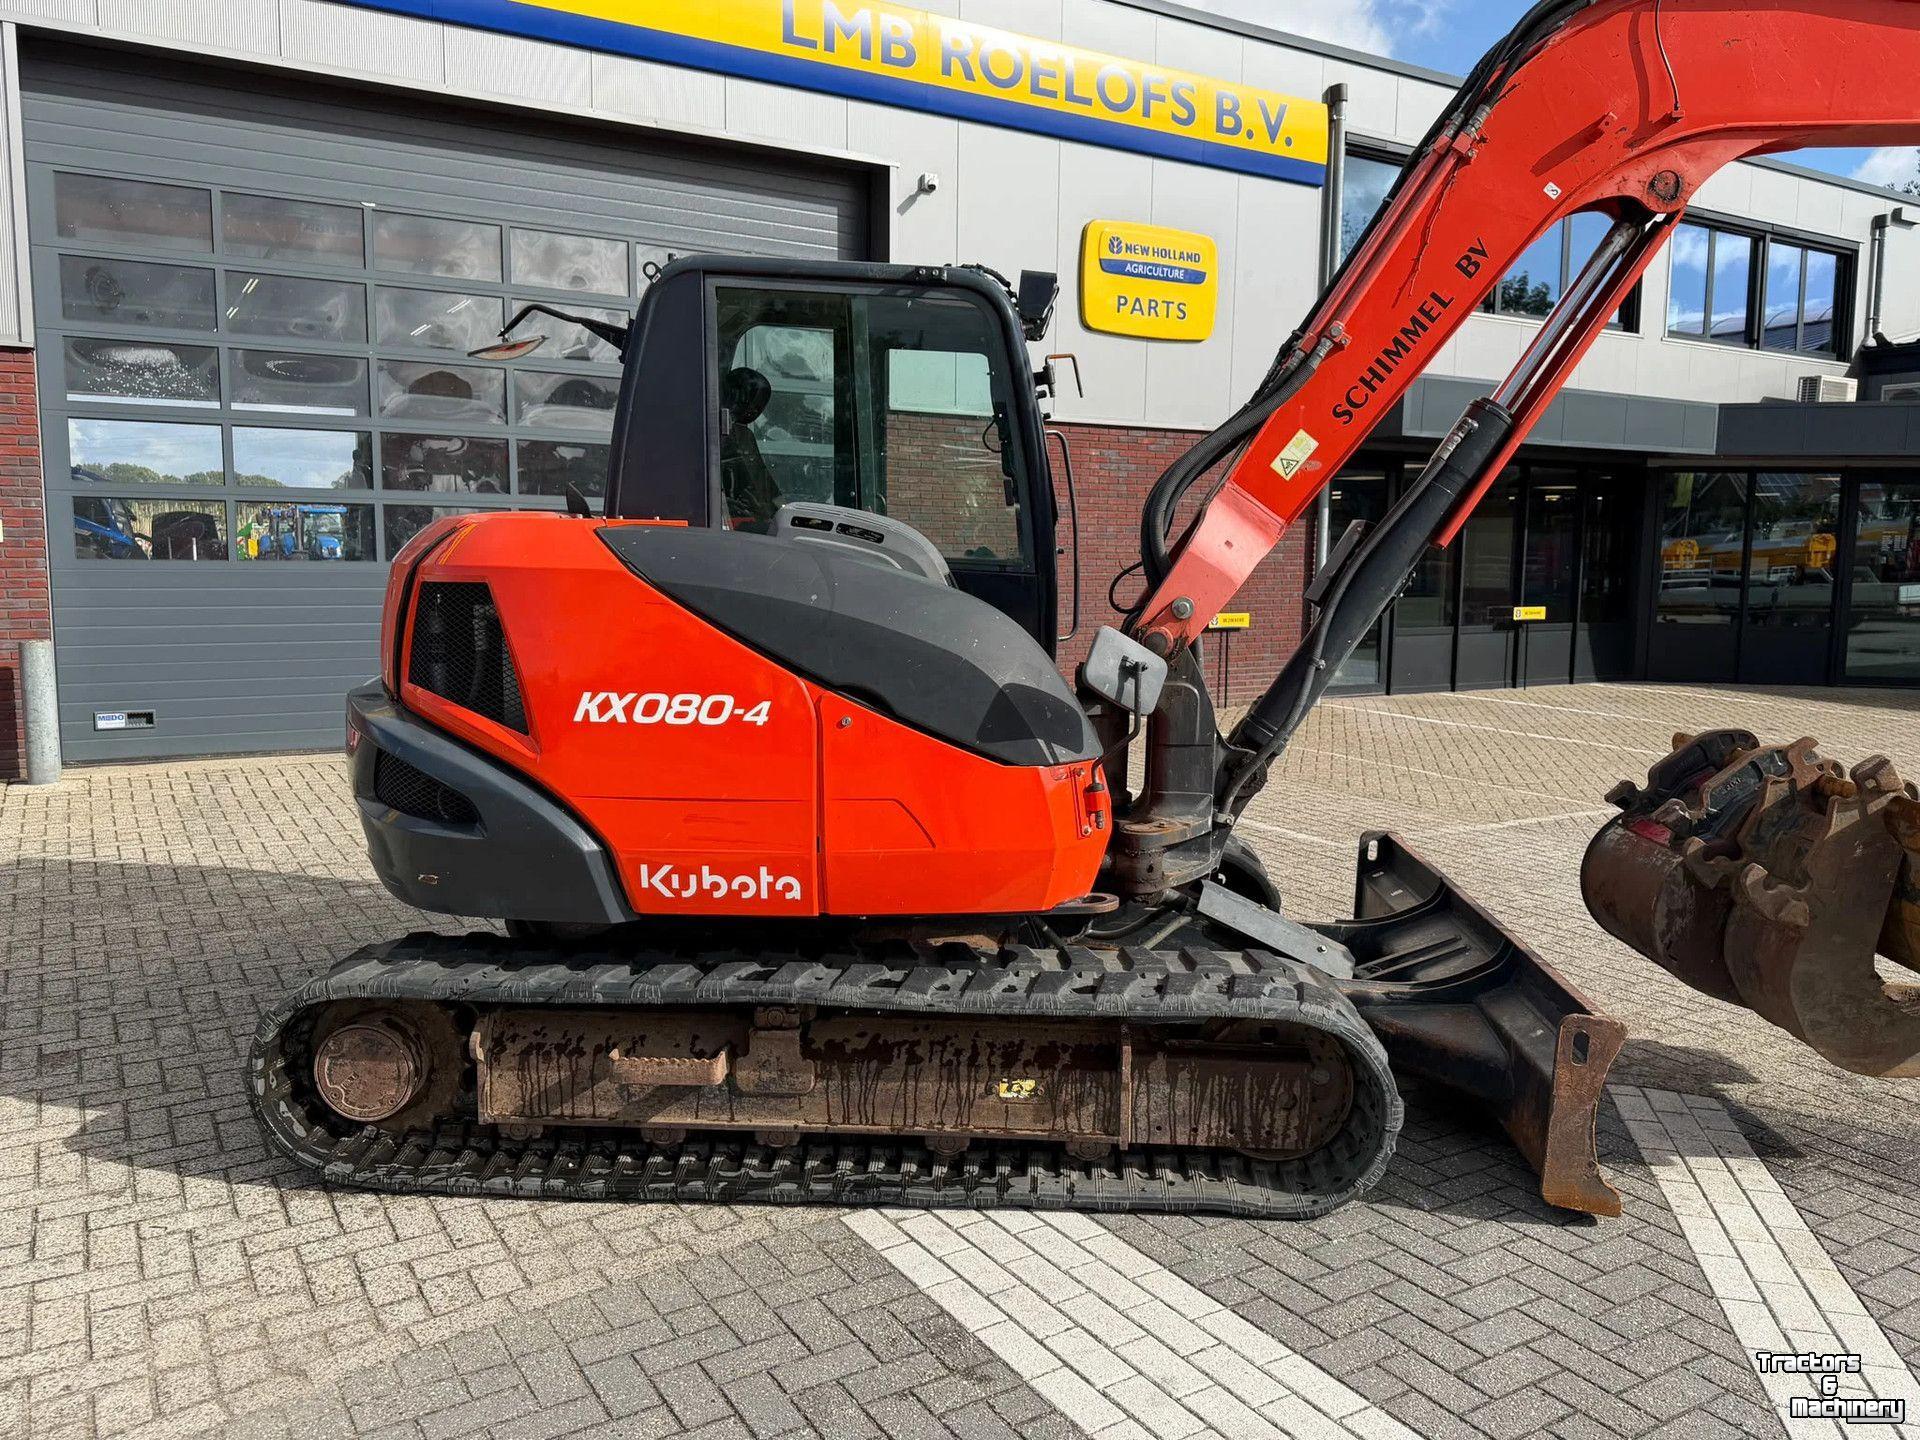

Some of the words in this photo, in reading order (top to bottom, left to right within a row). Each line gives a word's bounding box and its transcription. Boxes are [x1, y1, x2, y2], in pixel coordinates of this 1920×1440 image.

[782, 0, 917, 69] LMB
[940, 22, 1197, 127] ROELOFS
[1215, 90, 1293, 147] B.V.
[1125, 243, 1150, 256] NEW
[1152, 247, 1201, 263] HOLLAND
[1125, 263, 1185, 279] AGRICULTURE
[1116, 295, 1188, 320] PARTS
[1332, 291, 1456, 425] SCHIMMEL
[1455, 237, 1491, 279] BV
[573, 691, 772, 726] KX080-4
[639, 863, 801, 900] Kubota
